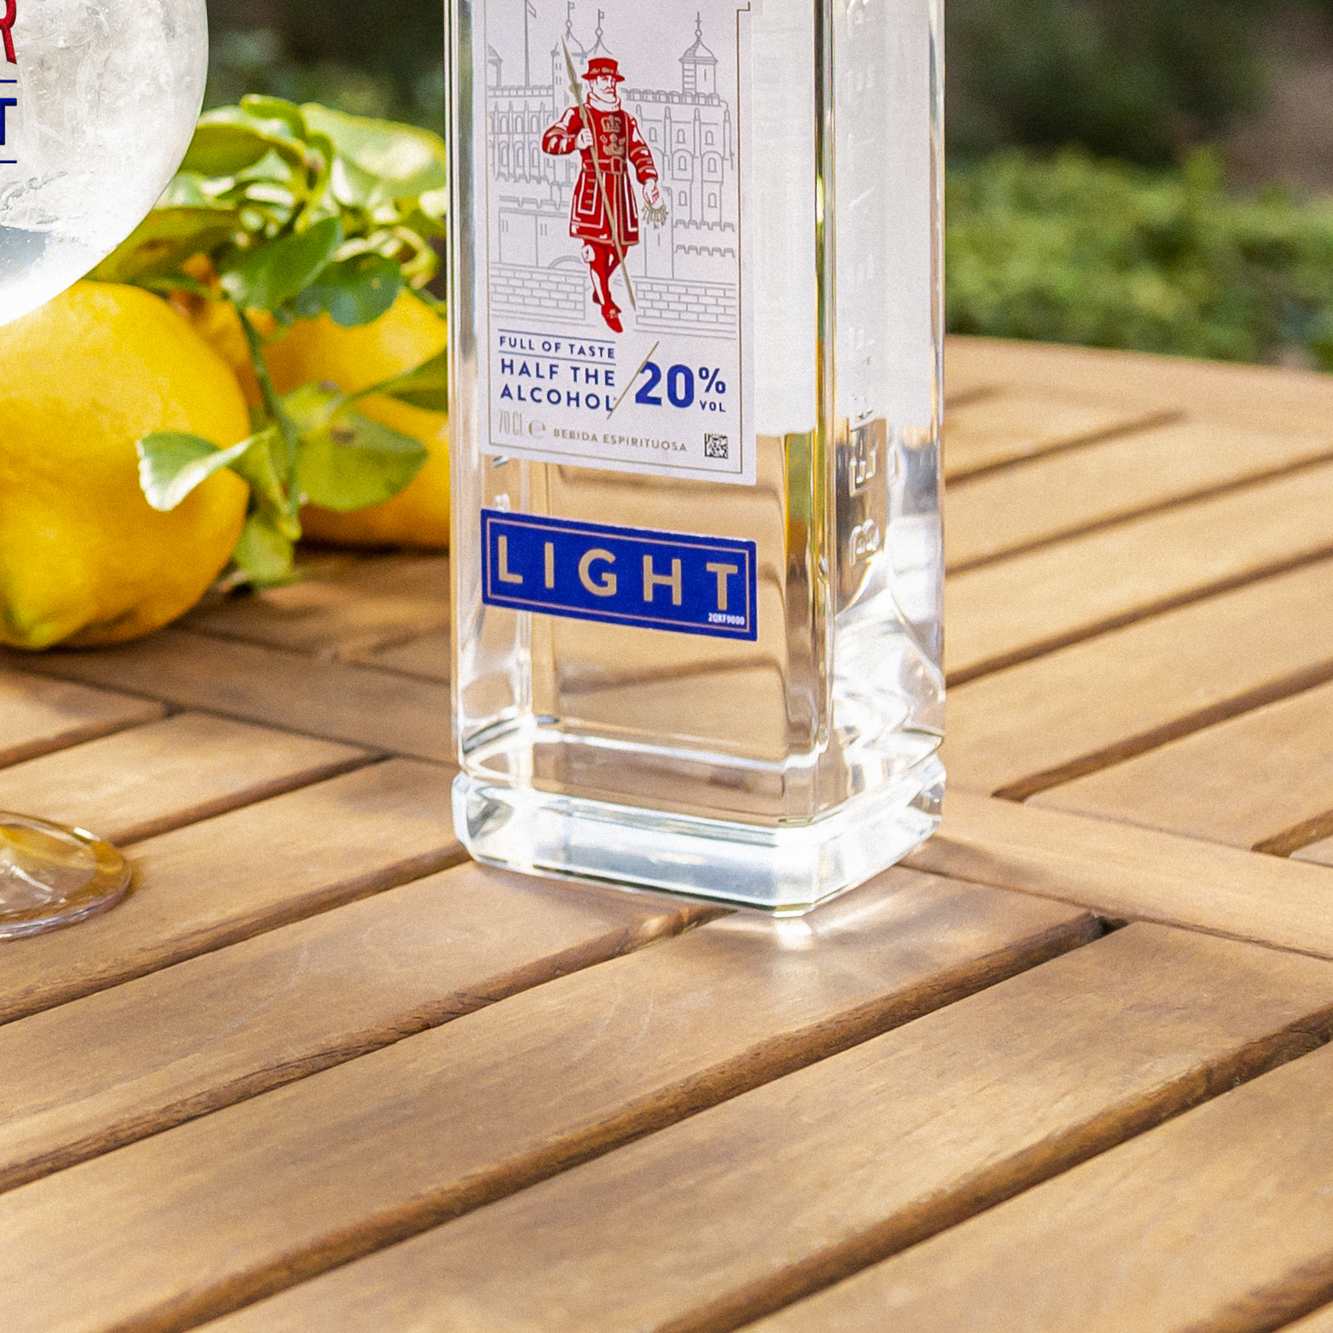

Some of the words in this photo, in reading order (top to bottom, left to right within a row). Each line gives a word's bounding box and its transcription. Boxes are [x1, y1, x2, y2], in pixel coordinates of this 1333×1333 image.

[499, 335, 535, 351] FULL
[541, 340, 562, 353] OF
[569, 343, 616, 359] TASTE
[501, 358, 560, 380] HALF
[570, 366, 616, 387] THE
[635, 361, 727, 409] 20%
[699, 400, 727, 413] VOL
[500, 383, 615, 412] ALCOHOL
[553, 428, 599, 443] BEBIDA
[603, 433, 689, 453] ESPIRITUOSA
[498, 535, 739, 611] LIGHT
